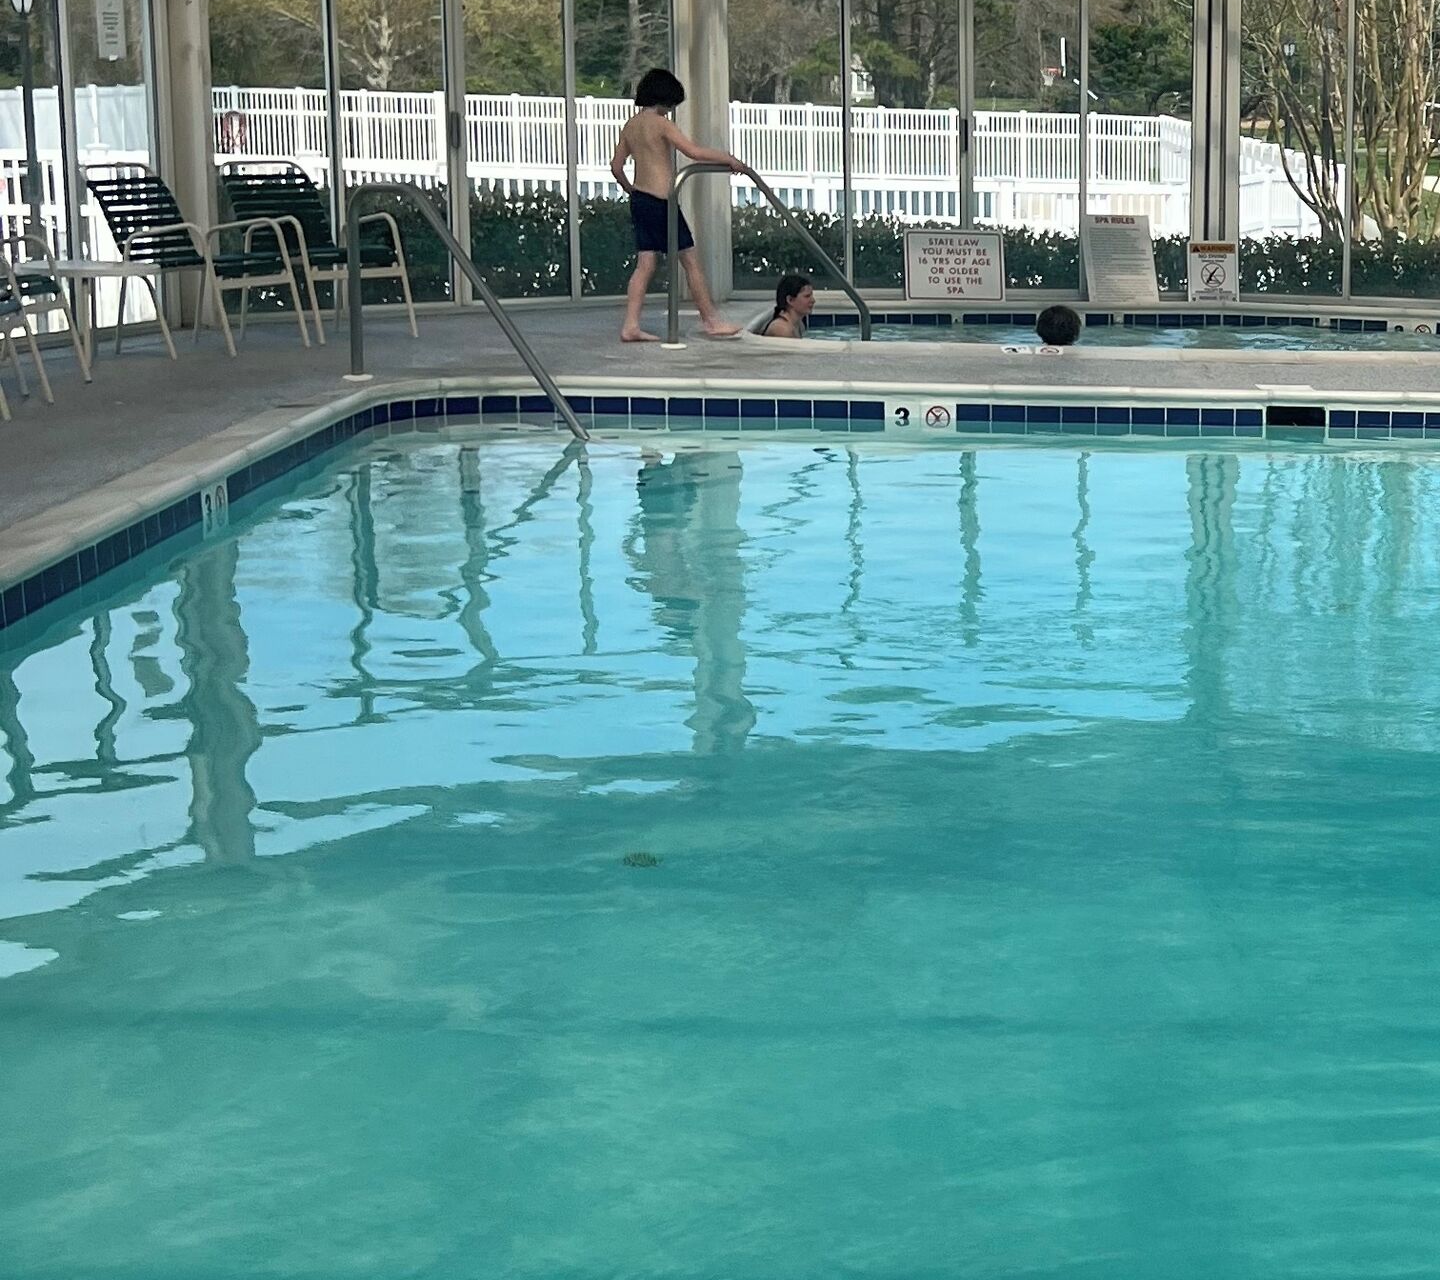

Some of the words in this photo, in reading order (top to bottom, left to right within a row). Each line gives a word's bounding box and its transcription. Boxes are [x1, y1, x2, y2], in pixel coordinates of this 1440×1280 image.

[1095, 216, 1109, 224] SPA
[928, 238, 954, 246] STATE
[946, 248, 972, 256] MUST
[932, 257, 950, 265] YRS
[971, 258, 991, 266] AGE
[949, 267, 979, 275] OLDER
[966, 277, 983, 285] THE
[894, 407, 910, 427] 3
